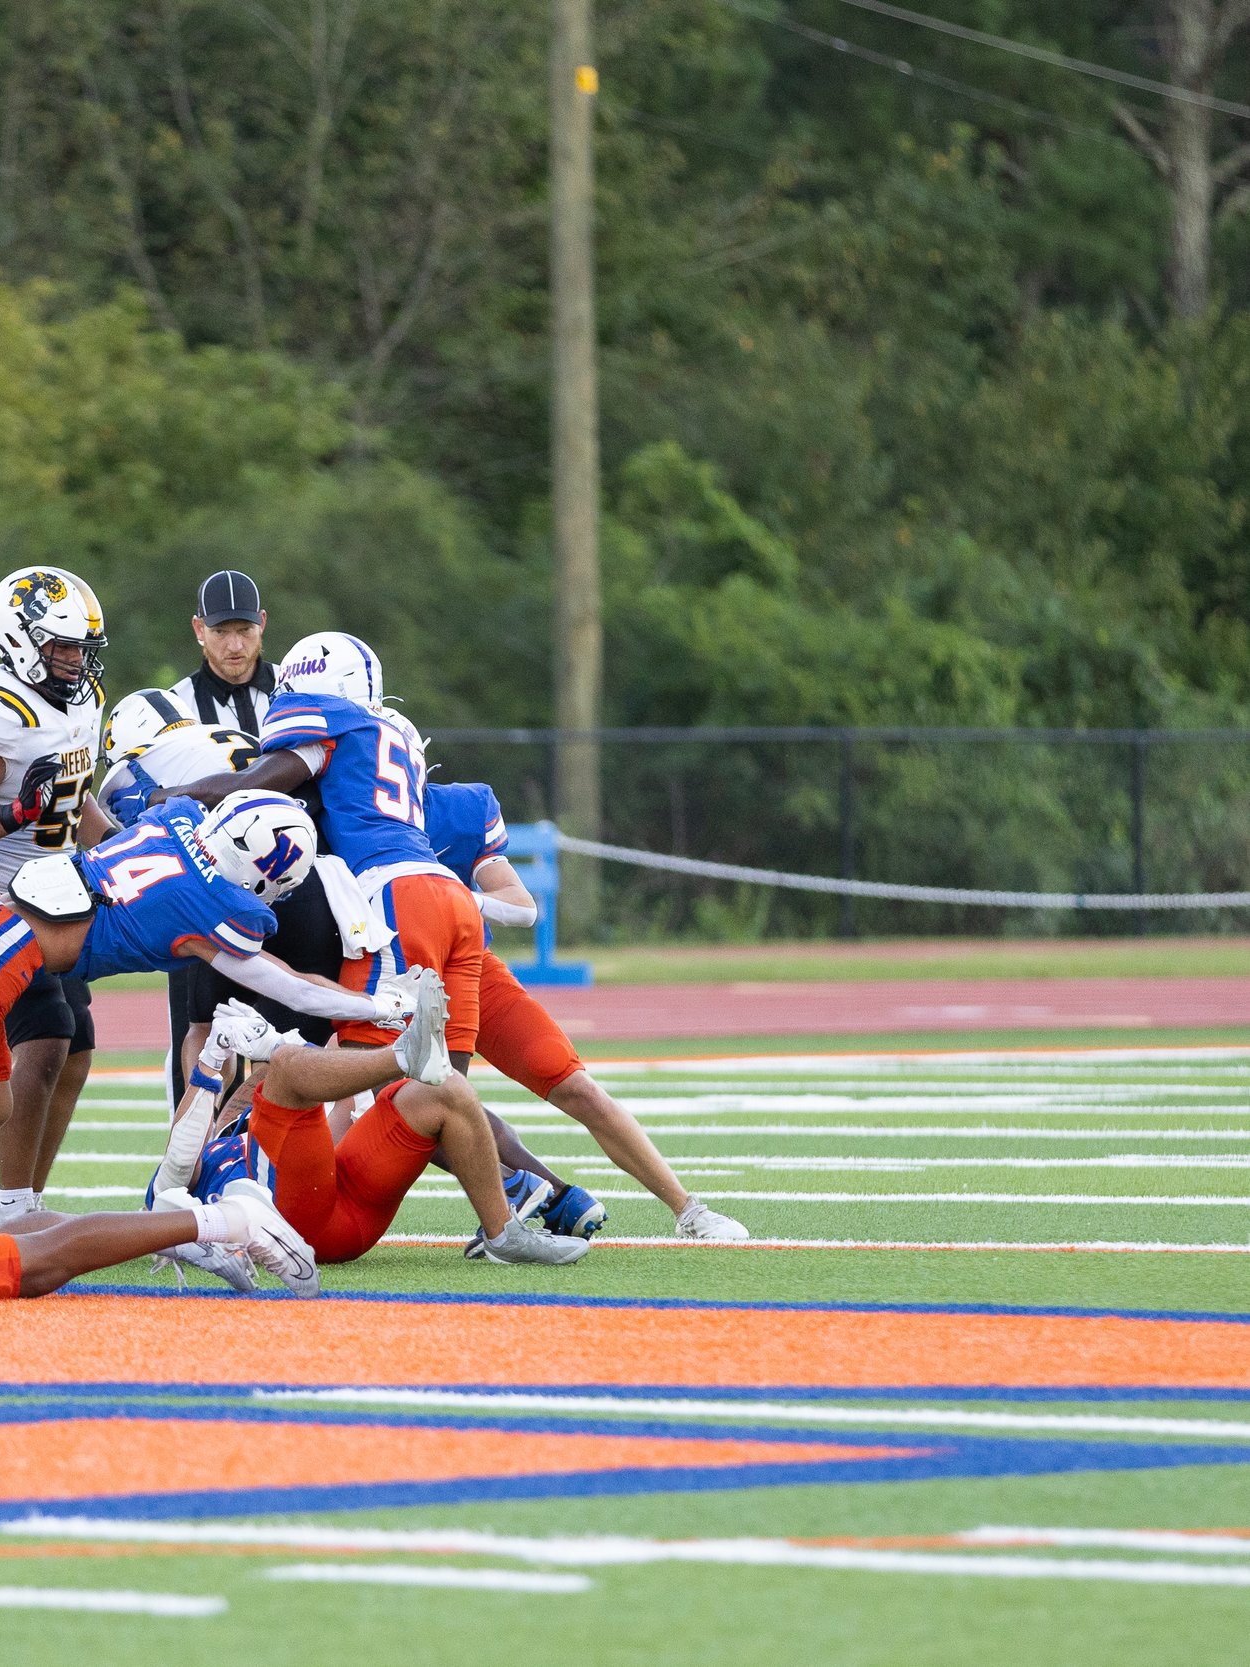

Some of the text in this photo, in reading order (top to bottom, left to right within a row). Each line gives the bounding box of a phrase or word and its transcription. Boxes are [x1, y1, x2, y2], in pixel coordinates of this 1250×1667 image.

[59, 746, 92, 778] NEERS
[86, 824, 187, 906] 14
[251, 831, 305, 883] N
